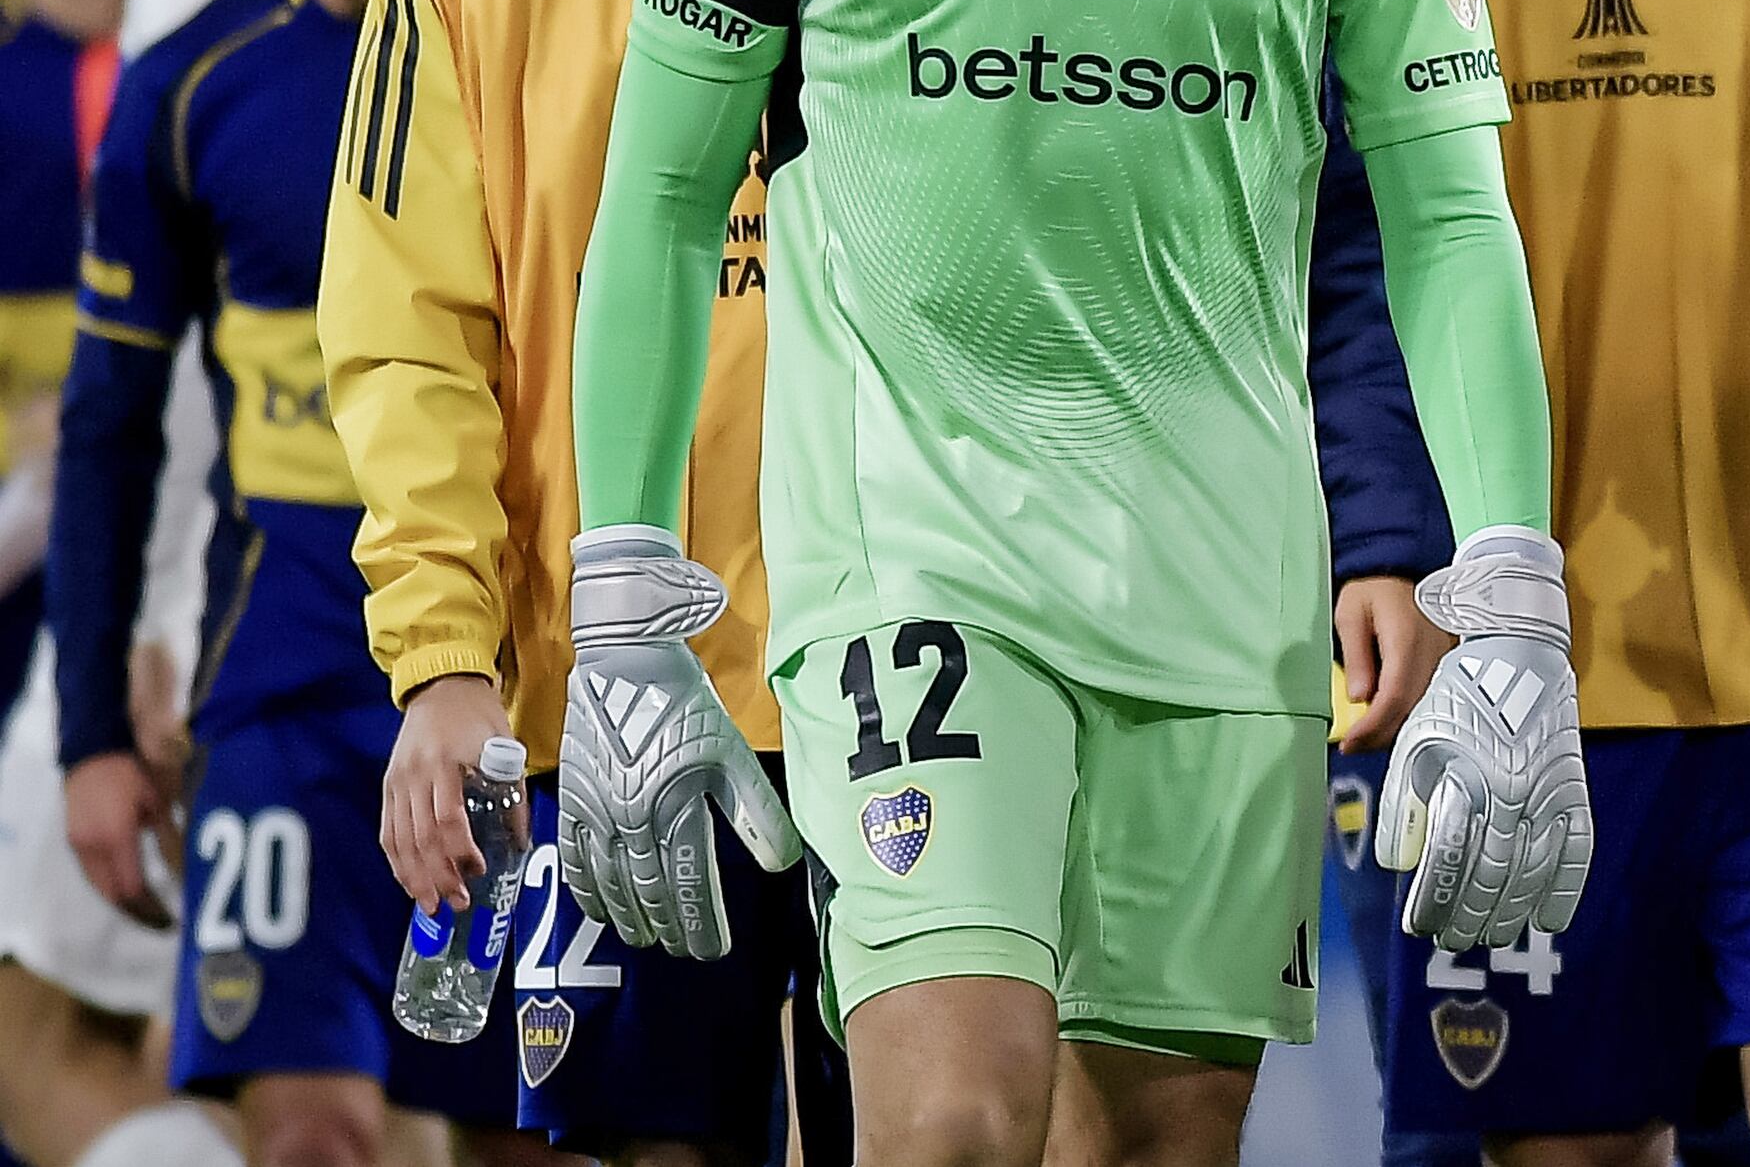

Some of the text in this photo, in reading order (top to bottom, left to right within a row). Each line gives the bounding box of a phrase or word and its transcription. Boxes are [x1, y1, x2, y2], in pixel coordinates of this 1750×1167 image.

[906, 31, 1258, 123] betsson
[1511, 72, 1716, 105] LIBERTADORES
[839, 620, 982, 783] 12
[868, 812, 927, 844] CABJ
[195, 805, 311, 951] 20
[484, 870, 521, 958] smart
[675, 842, 704, 932] adidas
